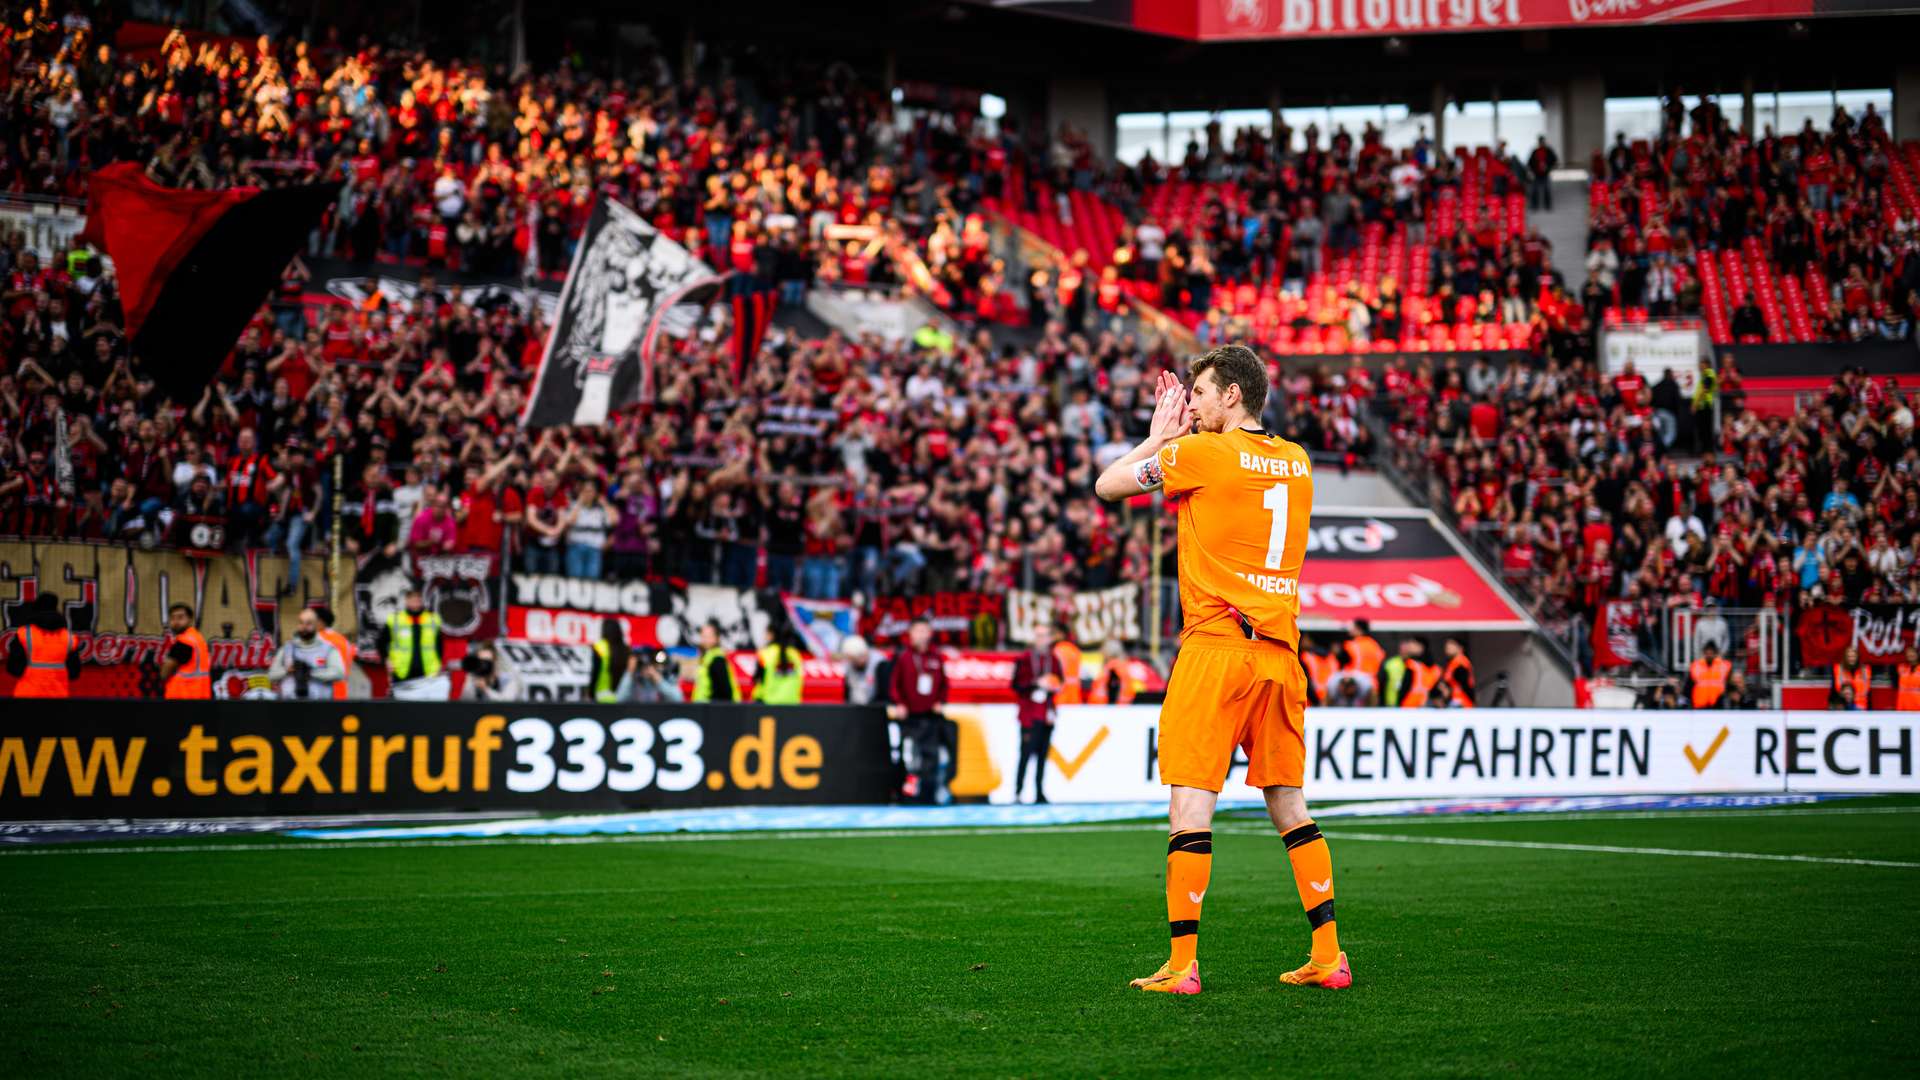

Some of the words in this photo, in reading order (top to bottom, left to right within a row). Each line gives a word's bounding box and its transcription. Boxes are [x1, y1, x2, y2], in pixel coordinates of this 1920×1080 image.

[1240, 452, 1289, 476] BAYER
[1292, 460, 1309, 477] 04
[1263, 483, 1289, 570] 1
[513, 573, 651, 616] YOUNG
[1235, 572, 1297, 595] ADECKY
[526, 610, 632, 645] BOY
[1848, 607, 1906, 656] Red
[210, 630, 275, 669] mit
[0, 714, 823, 797] ww.taxiruf3333.de
[1147, 726, 1651, 782] KENFAHRTEN
[1755, 728, 1912, 776] RECH
